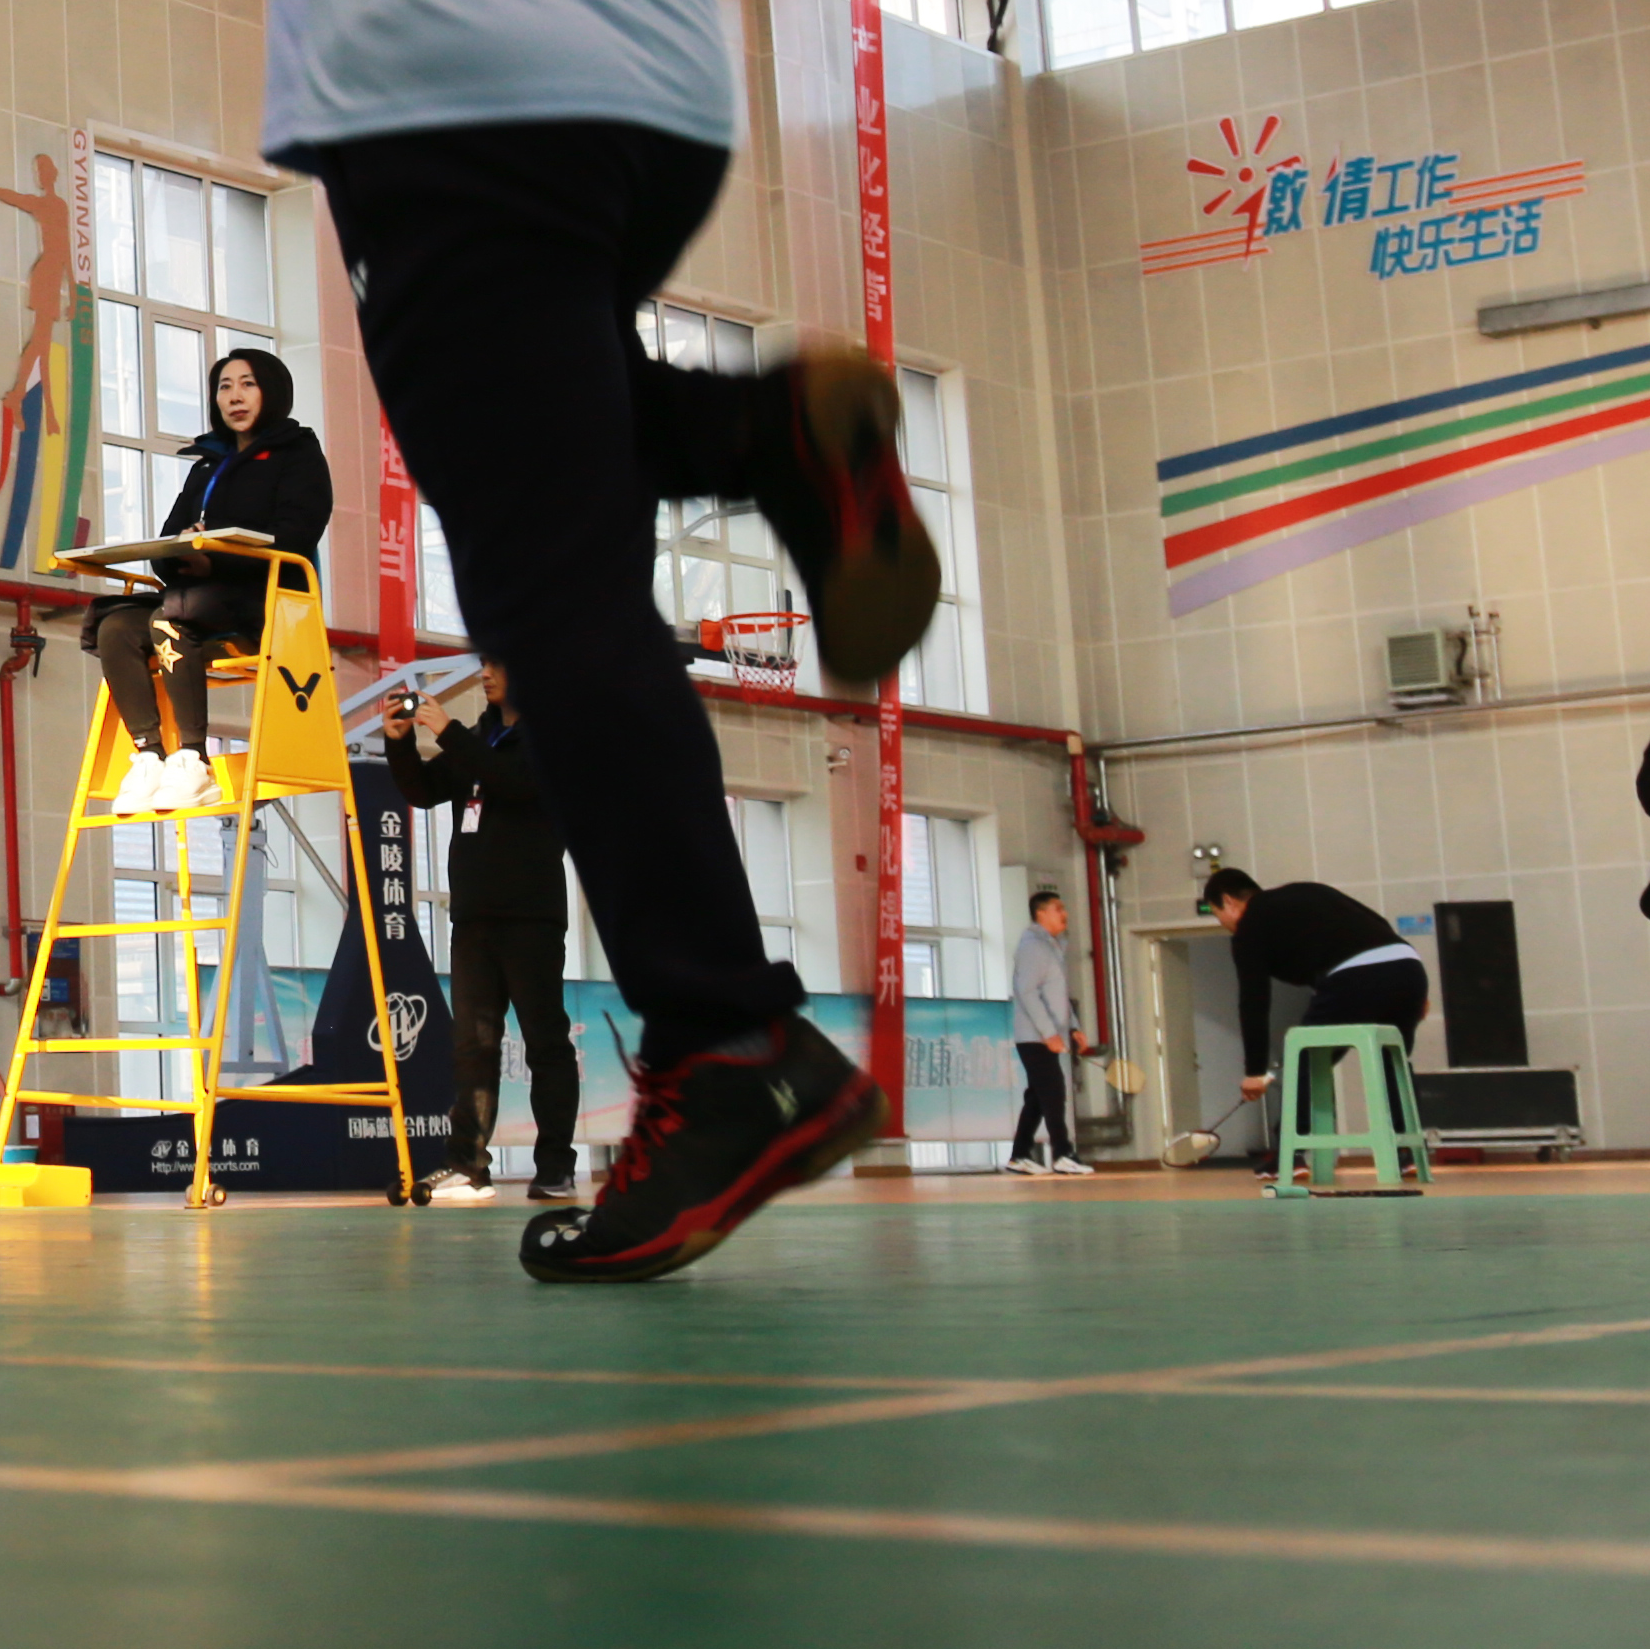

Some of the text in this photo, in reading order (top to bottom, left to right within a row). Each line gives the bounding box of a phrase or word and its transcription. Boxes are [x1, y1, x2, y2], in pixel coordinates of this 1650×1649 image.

[72, 128, 94, 345] GYMNASTICS
[1369, 196, 1544, 280] 快乐生活
[380, 810, 407, 940] 金陵体育
[176, 1137, 260, 1158] 金体育
